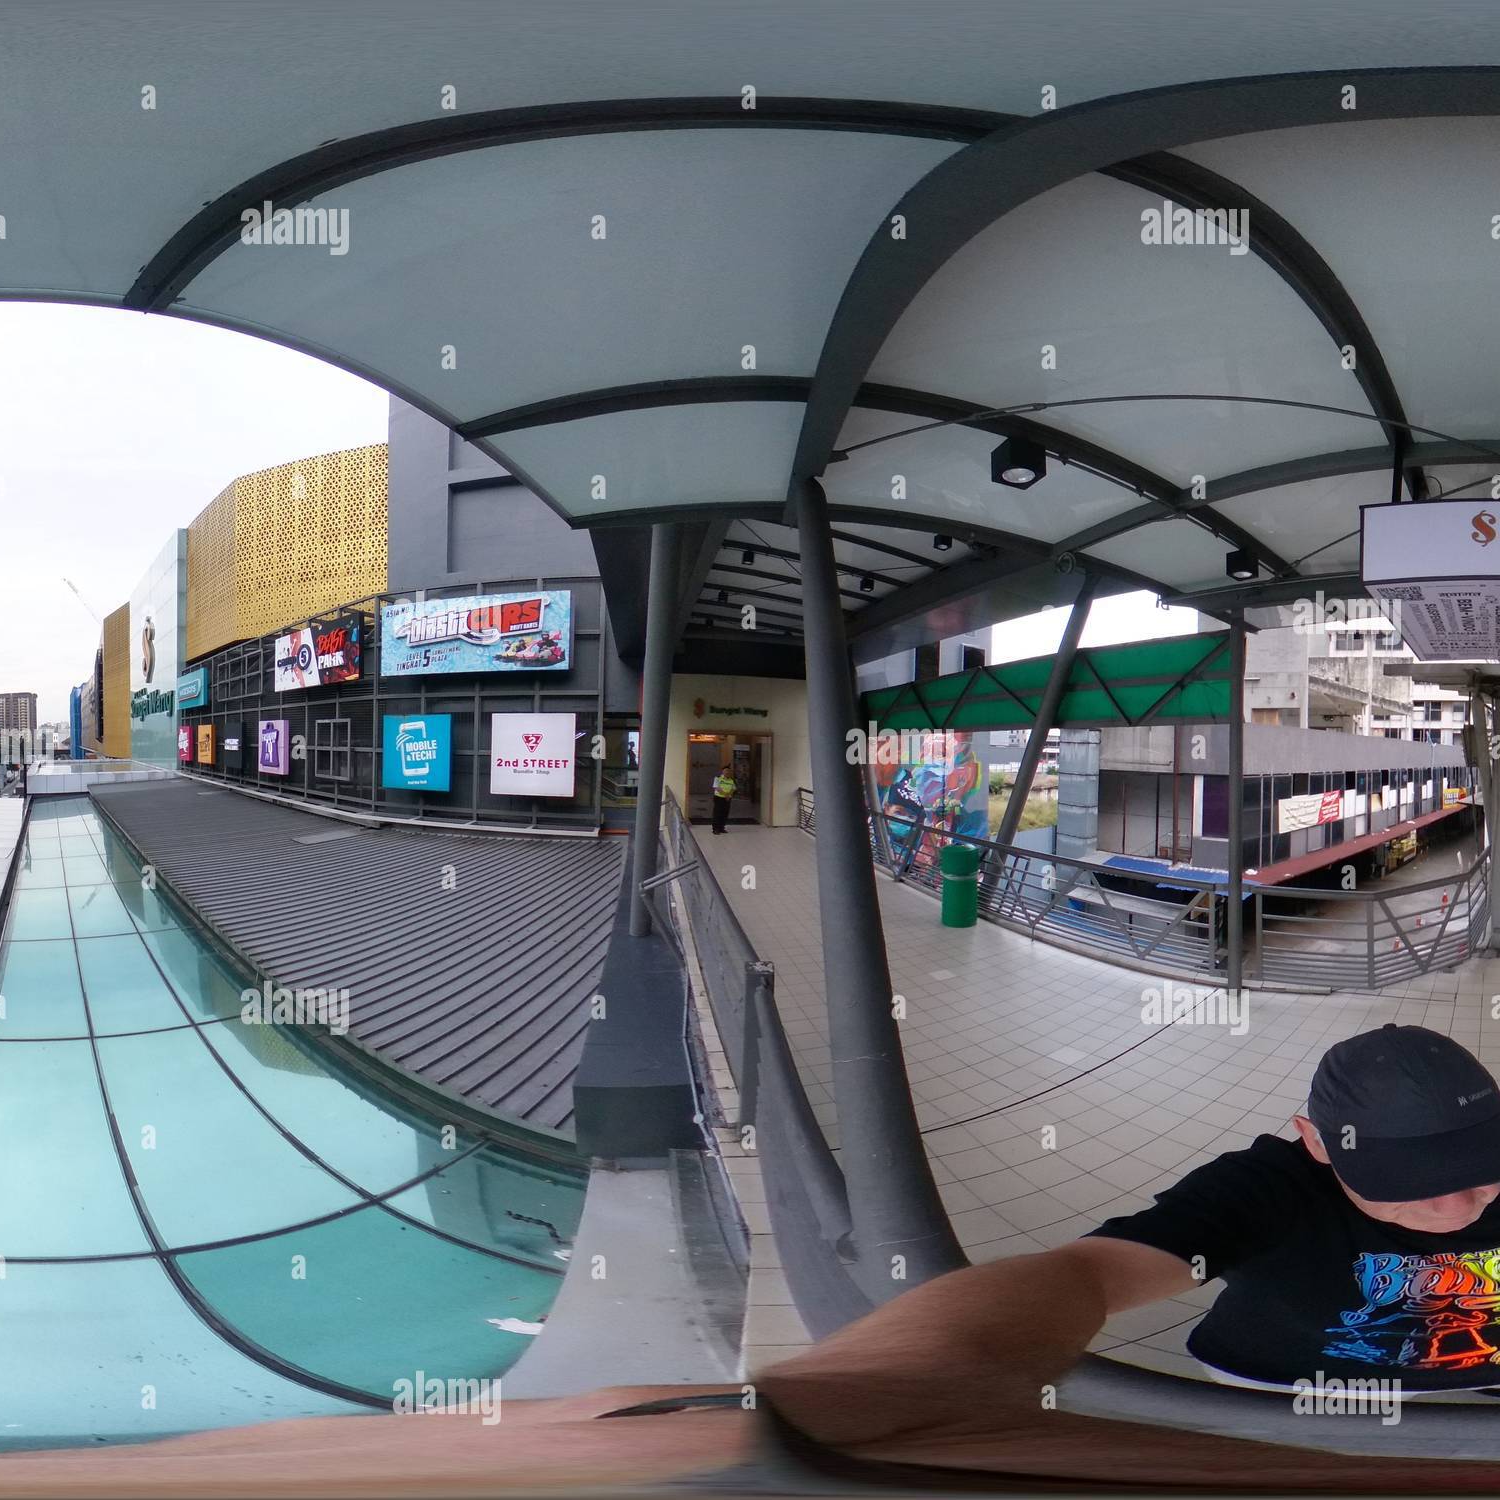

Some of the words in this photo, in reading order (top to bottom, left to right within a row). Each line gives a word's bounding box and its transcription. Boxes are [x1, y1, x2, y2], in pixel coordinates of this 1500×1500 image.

[318, 651, 344, 669] PARK
[423, 649, 431, 667] 5
[406, 740, 437, 752] MOBILE
[497, 759, 518, 767] 2nd
[523, 759, 569, 768] STREET
